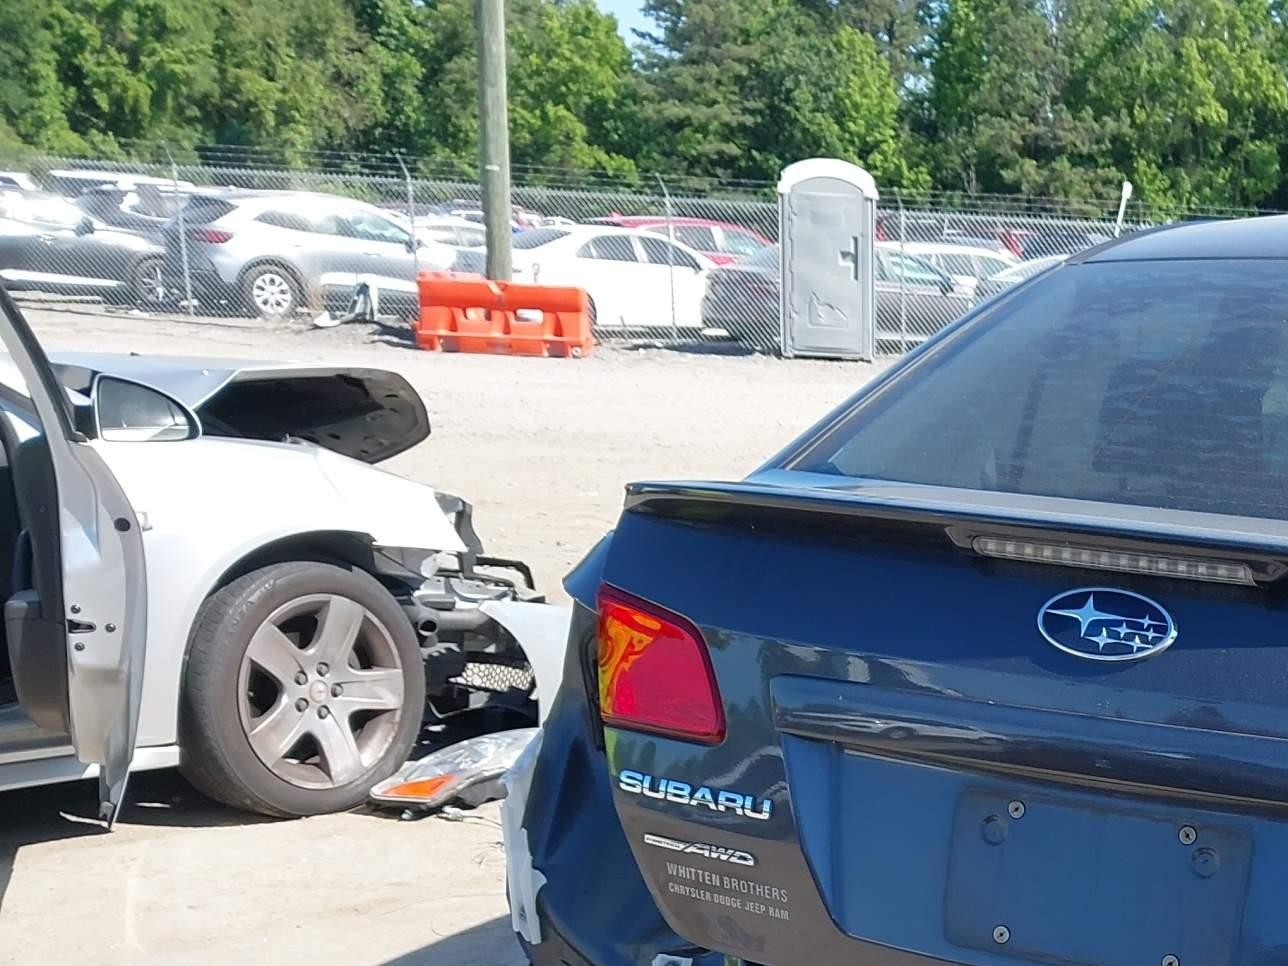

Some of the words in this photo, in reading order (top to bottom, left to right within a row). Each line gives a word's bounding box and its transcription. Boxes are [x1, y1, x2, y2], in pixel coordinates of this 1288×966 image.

[619, 769, 772, 820] SUBARU
[683, 843, 755, 866] AWD
[666, 862, 720, 886] WHITTEN
[723, 876, 788, 903] BROTHERS
[668, 882, 711, 901] CHRYSLER
[713, 894, 742, 909] DODGE
[744, 901, 766, 914] JEEP
[768, 907, 789, 920] RAM
